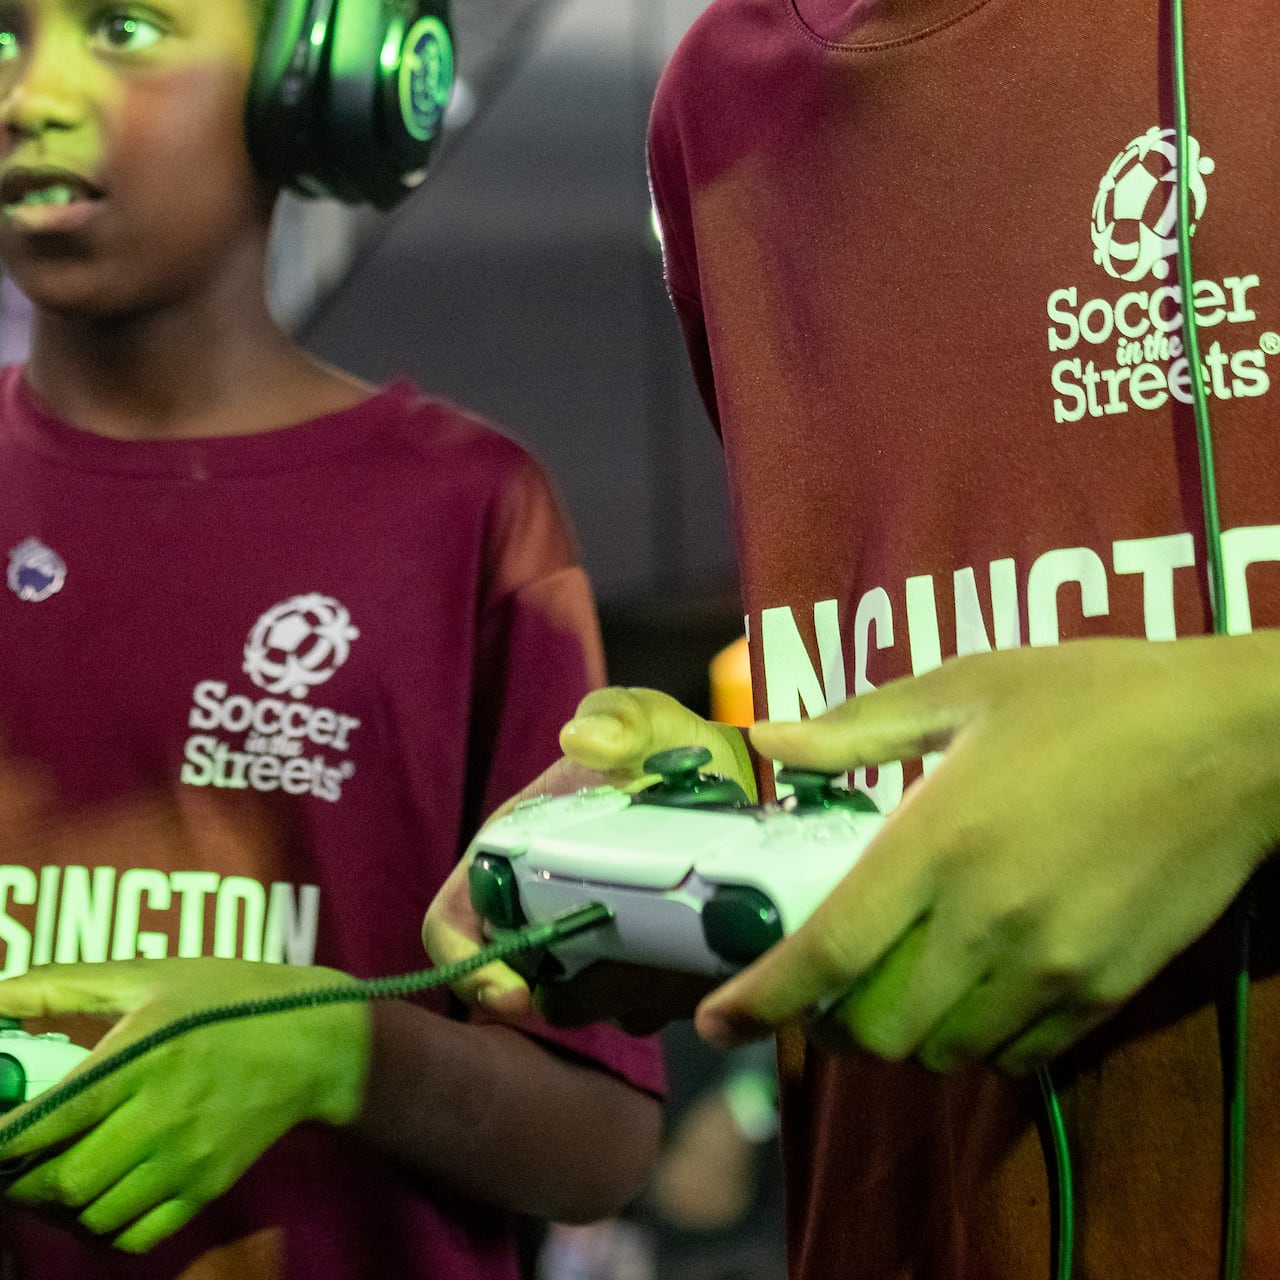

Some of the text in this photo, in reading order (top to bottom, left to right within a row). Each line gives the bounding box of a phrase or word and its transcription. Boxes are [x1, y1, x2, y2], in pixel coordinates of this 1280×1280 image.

[1047, 274, 1260, 352] Soccer
[1116, 337, 1143, 367] in
[188, 679, 362, 752] Soccer
